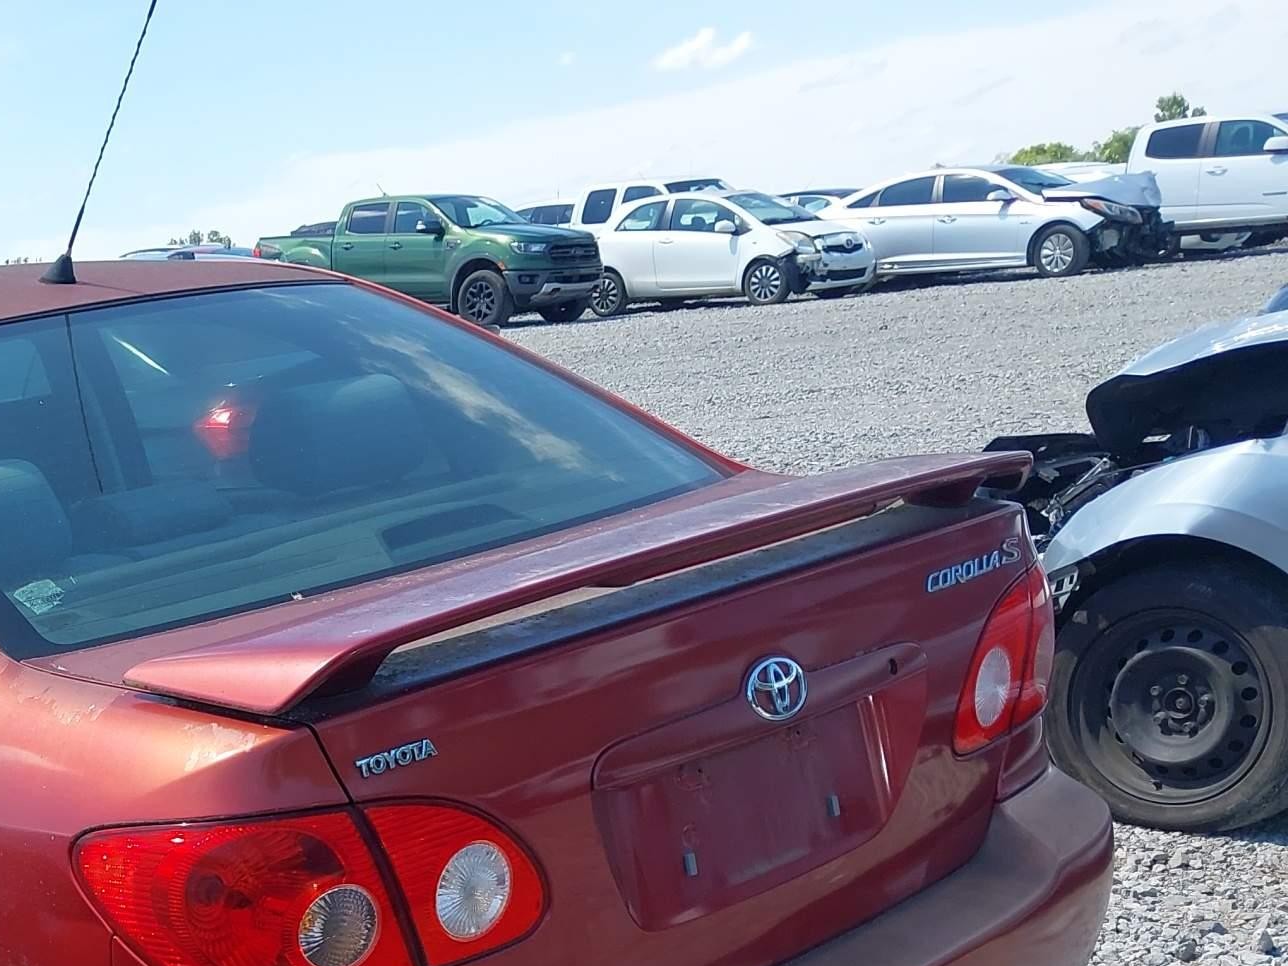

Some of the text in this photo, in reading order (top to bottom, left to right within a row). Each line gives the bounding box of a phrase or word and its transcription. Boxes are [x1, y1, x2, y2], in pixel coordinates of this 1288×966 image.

[927, 537, 1022, 592] COROLLA S
[355, 738, 438, 778] TOYOTA
